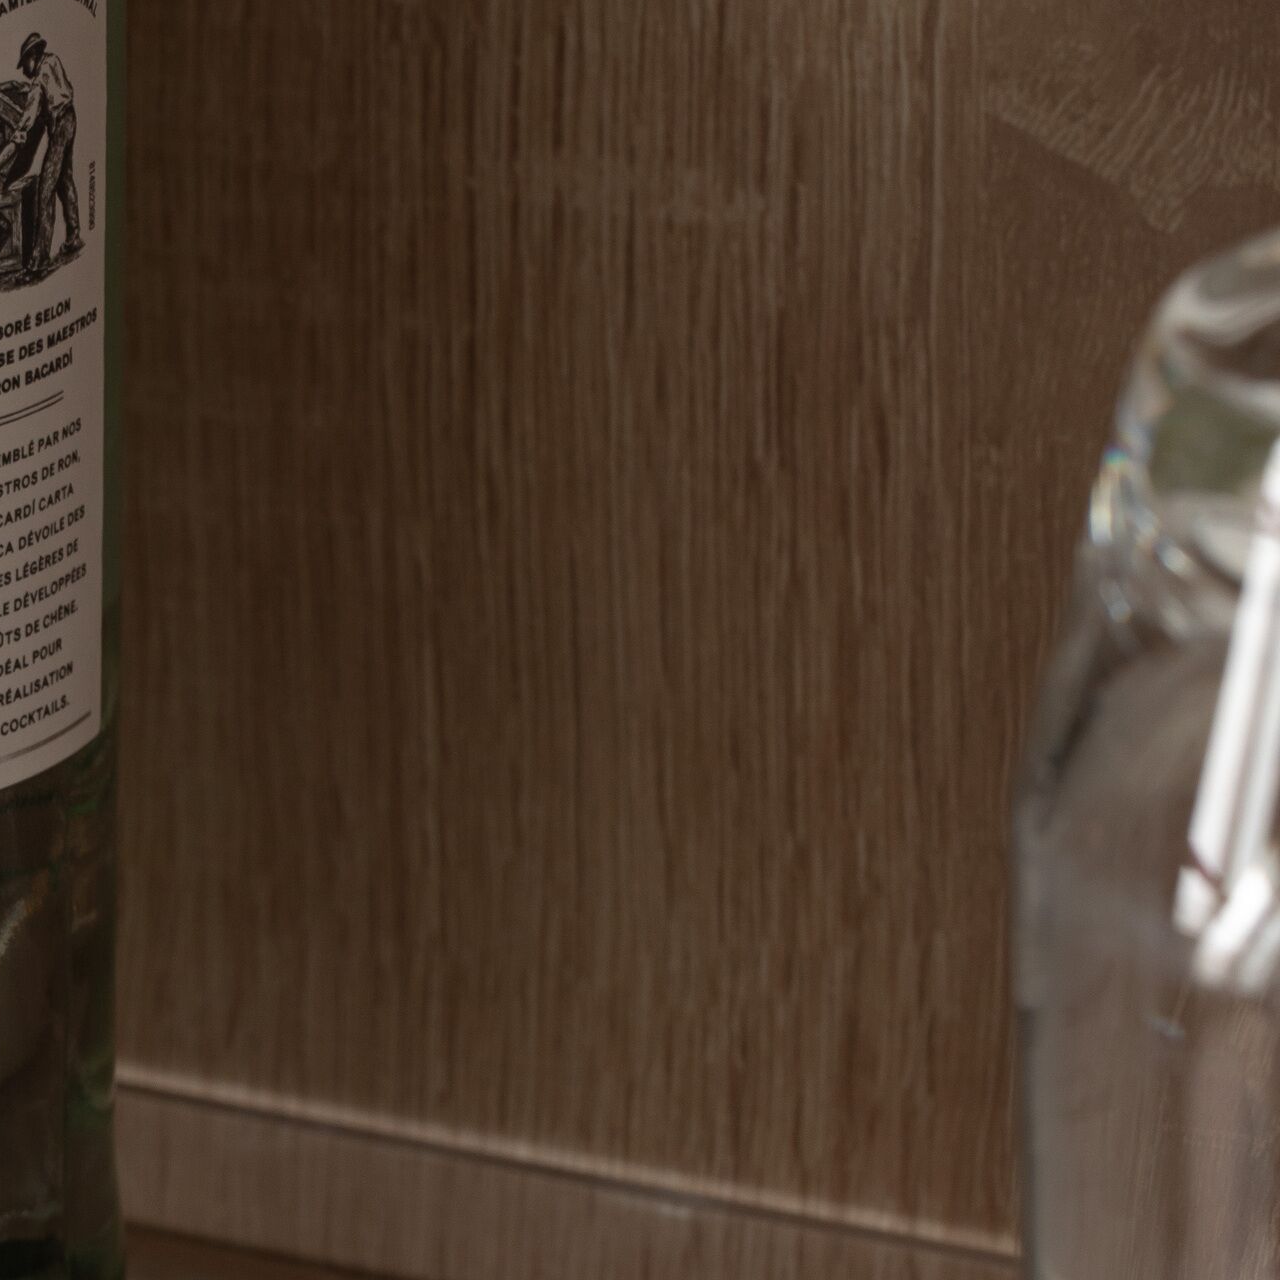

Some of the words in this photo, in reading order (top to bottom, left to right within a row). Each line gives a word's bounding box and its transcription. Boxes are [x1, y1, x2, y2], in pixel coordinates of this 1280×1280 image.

[35, 297, 71, 328] SELON
[18, 338, 44, 361] DES
[46, 307, 97, 349] MAESTROS
[25, 347, 73, 386] BACARDÍ
[37, 430, 60, 453] PAR
[62, 417, 82, 441] NOS
[41, 462, 55, 481] DE
[39, 482, 74, 511] CARTA
[18, 516, 65, 551] DÉVOILE
[67, 504, 86, 527] DES
[15, 548, 65, 582] LÉGÈRES
[13, 563, 87, 613] DÉVELOPPÉES
[25, 621, 40, 638] DE
[32, 638, 62, 665] POUR
